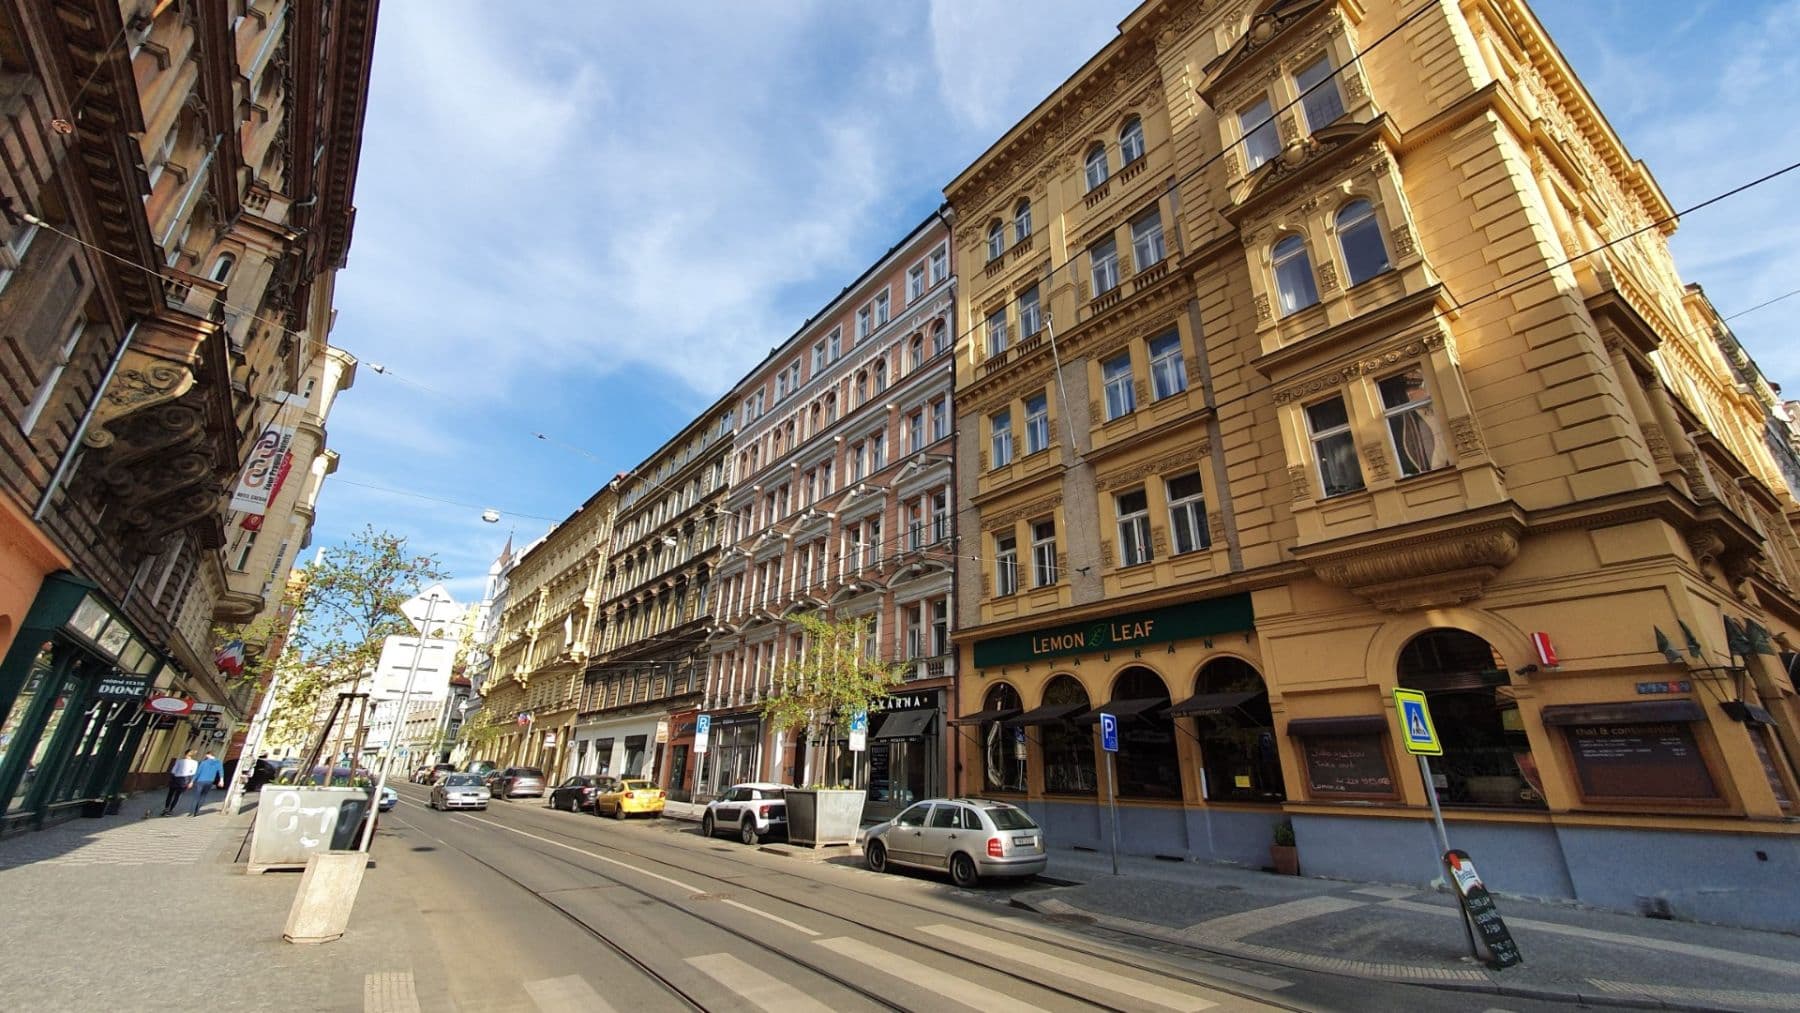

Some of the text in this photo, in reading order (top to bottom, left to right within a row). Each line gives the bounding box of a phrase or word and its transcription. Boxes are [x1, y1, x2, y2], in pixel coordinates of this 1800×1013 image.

[1032, 620, 1154, 654] LEMON LEAF
[98, 684, 145, 695] DIONE
[1104, 718, 1113, 739] P
